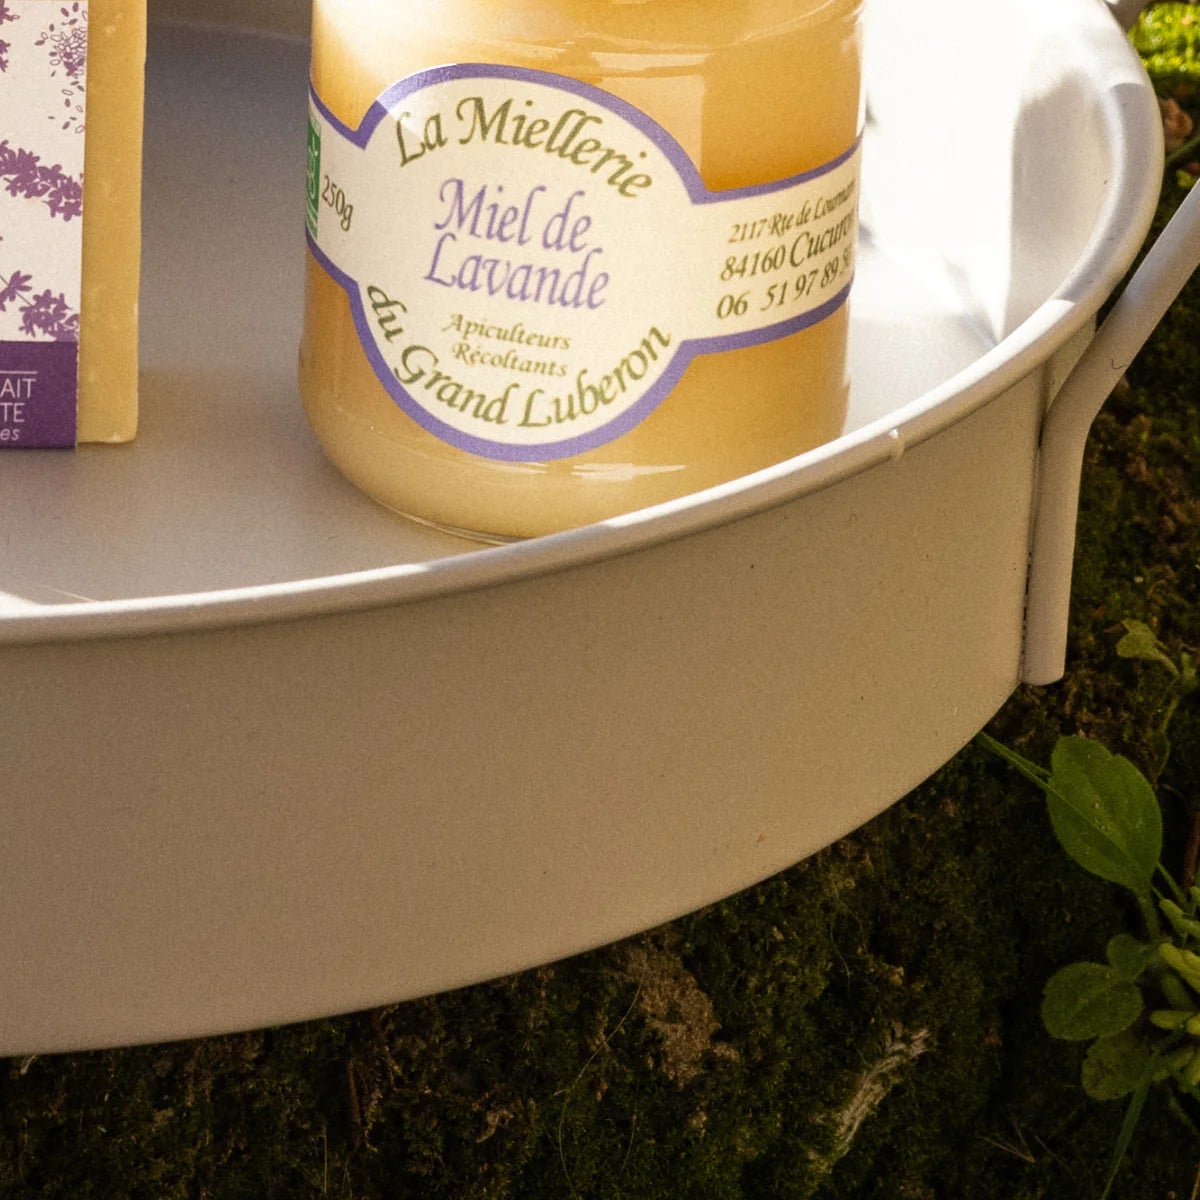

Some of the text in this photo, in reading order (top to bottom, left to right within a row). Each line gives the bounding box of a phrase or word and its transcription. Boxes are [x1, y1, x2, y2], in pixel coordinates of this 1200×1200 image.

[396, 96, 653, 198] La Miellerie
[321, 174, 354, 232] 250g
[432, 178, 592, 250] Miel de
[728, 217, 767, 244] 2117
[796, 200, 812, 227] de
[423, 233, 611, 311] Lavande
[716, 290, 751, 320] 06
[760, 280, 788, 312] 51
[794, 268, 819, 301] 97
[820, 256, 839, 289] 89
[720, 244, 786, 282] 84160
[367, 282, 672, 429] du Grand Luberon
[442, 313, 573, 350] Apiculteurs
[452, 341, 568, 377] Récoltants
